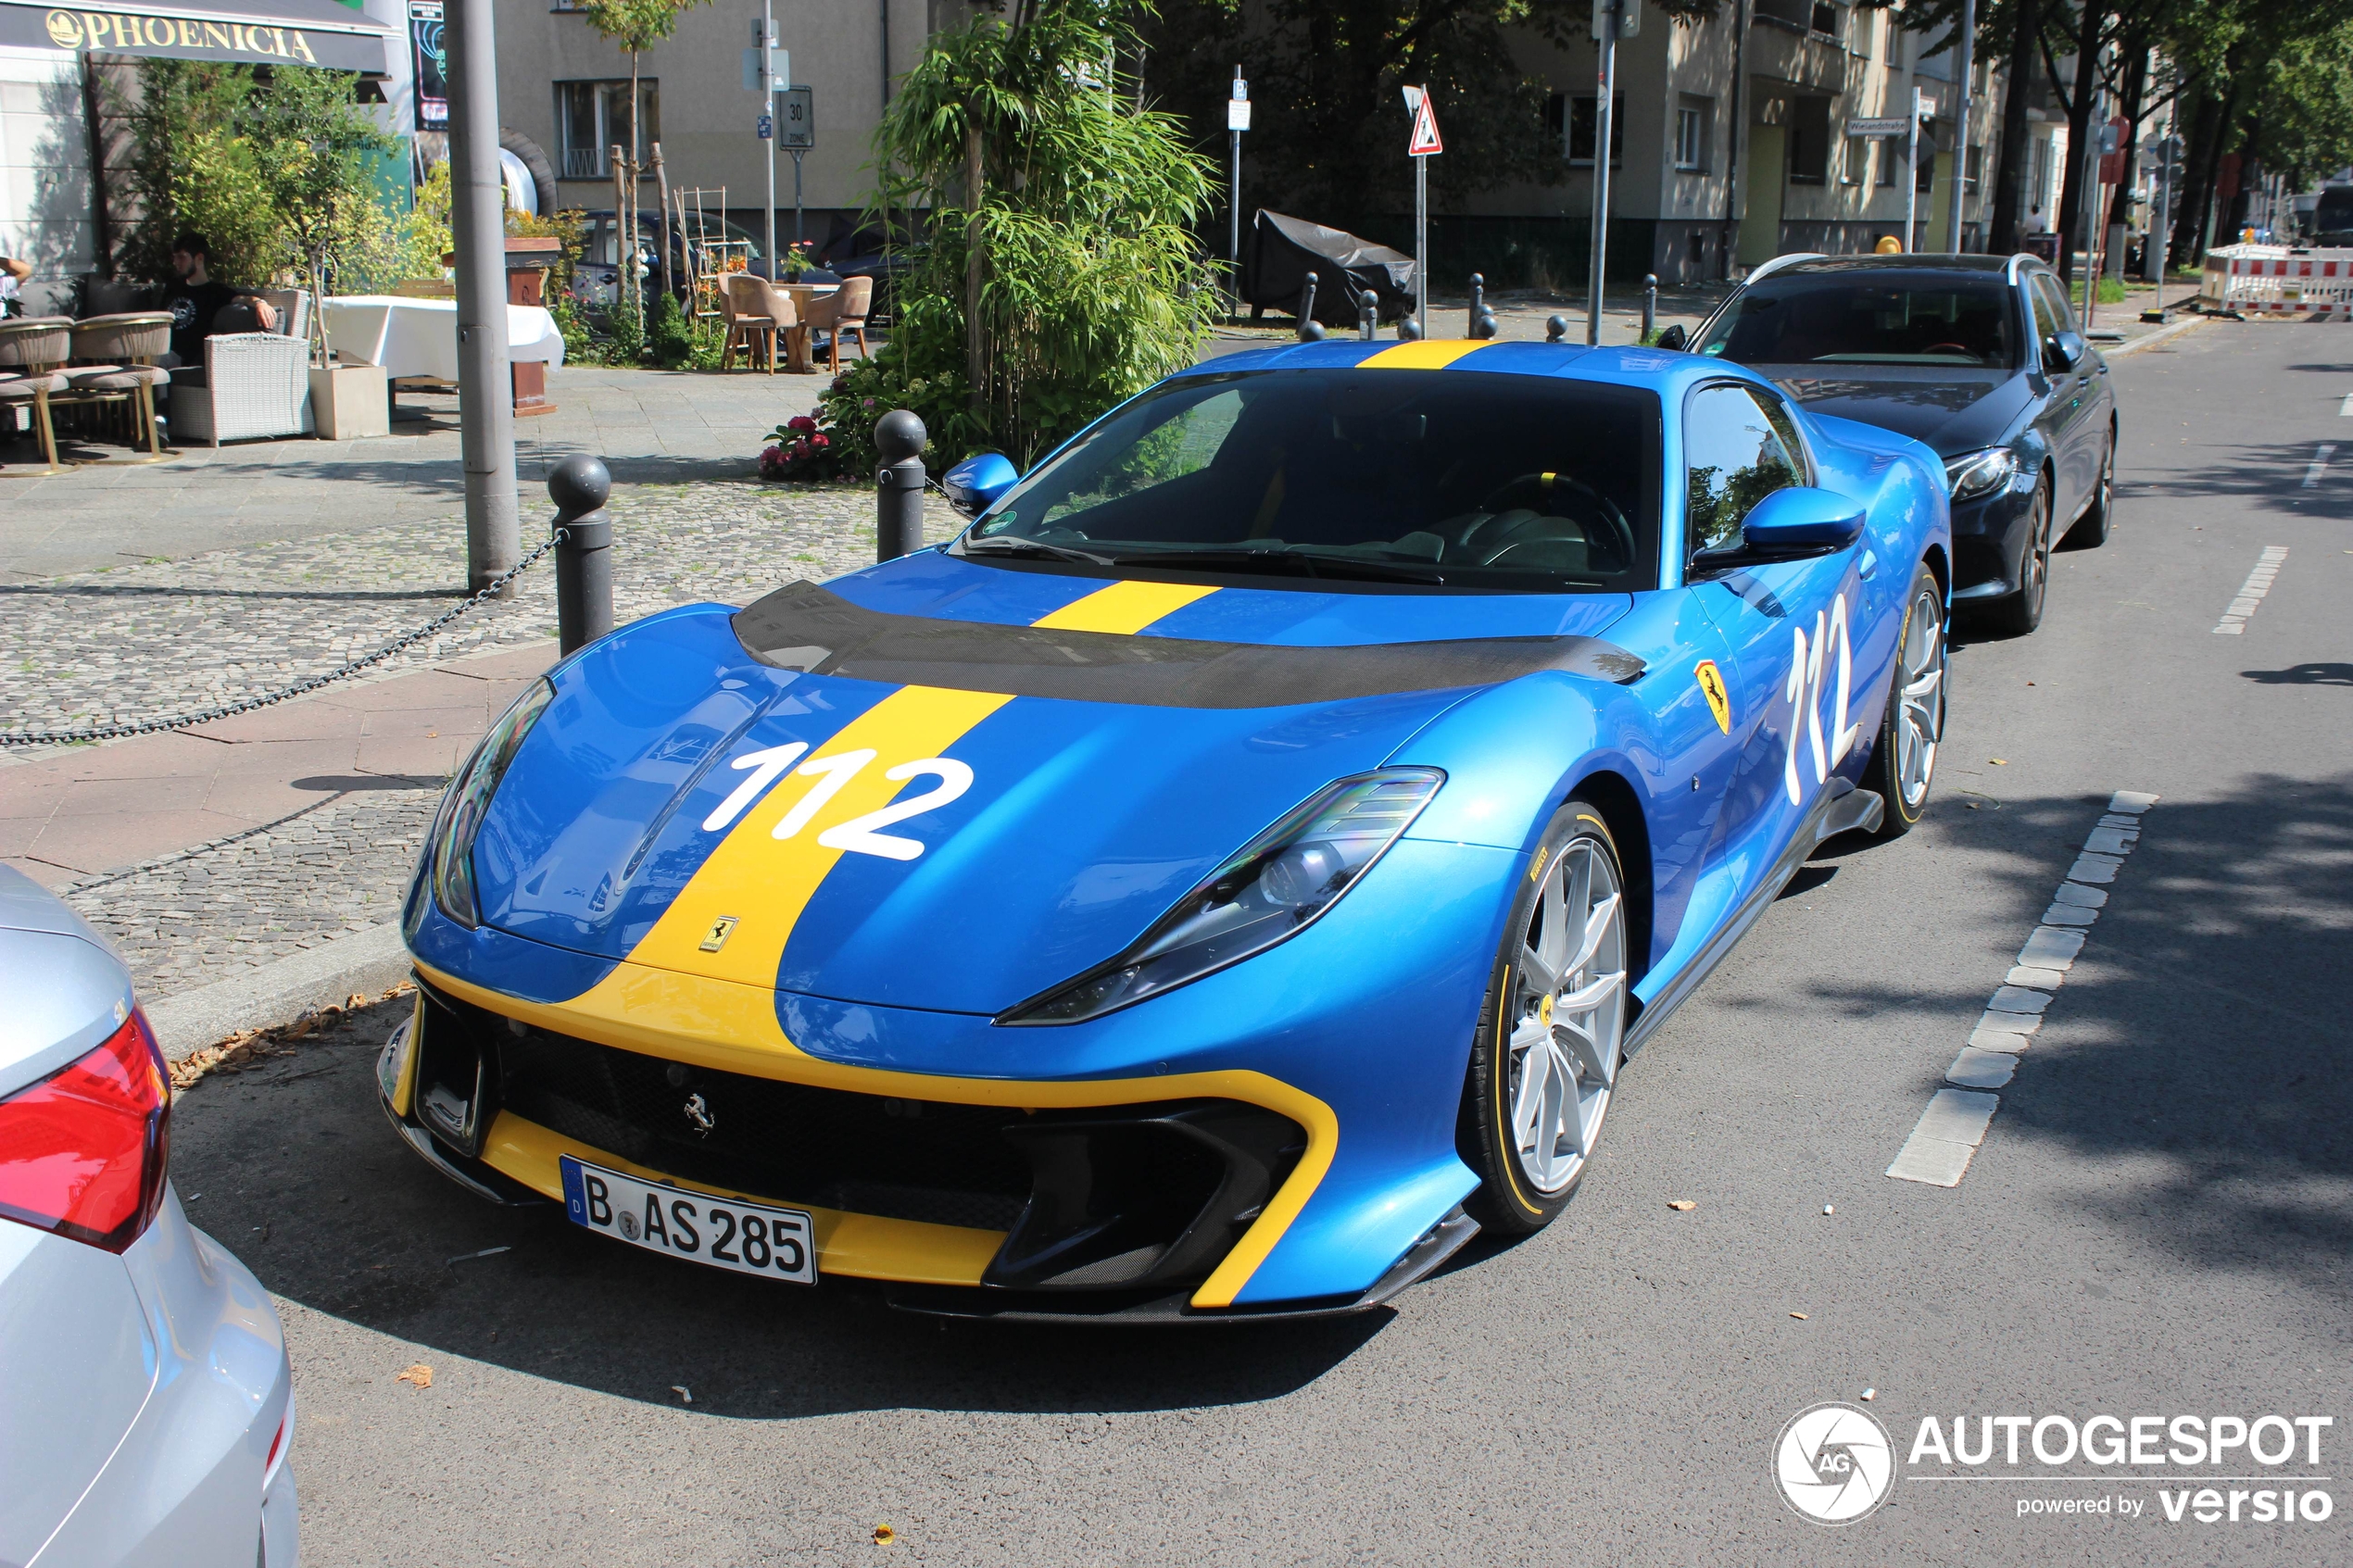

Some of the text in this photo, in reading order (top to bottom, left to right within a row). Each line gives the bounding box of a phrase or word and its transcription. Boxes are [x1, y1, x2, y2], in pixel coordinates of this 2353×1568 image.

[81, 12, 319, 64] PHOENICIA
[789, 103, 802, 121] 30
[789, 133, 805, 144] ZONE
[1785, 593, 1860, 807] 112
[702, 741, 975, 861] 112
[1529, 847, 1548, 882] PIRELLI
[573, 1199, 581, 1213] D
[585, 1173, 805, 1273] B AS 285
